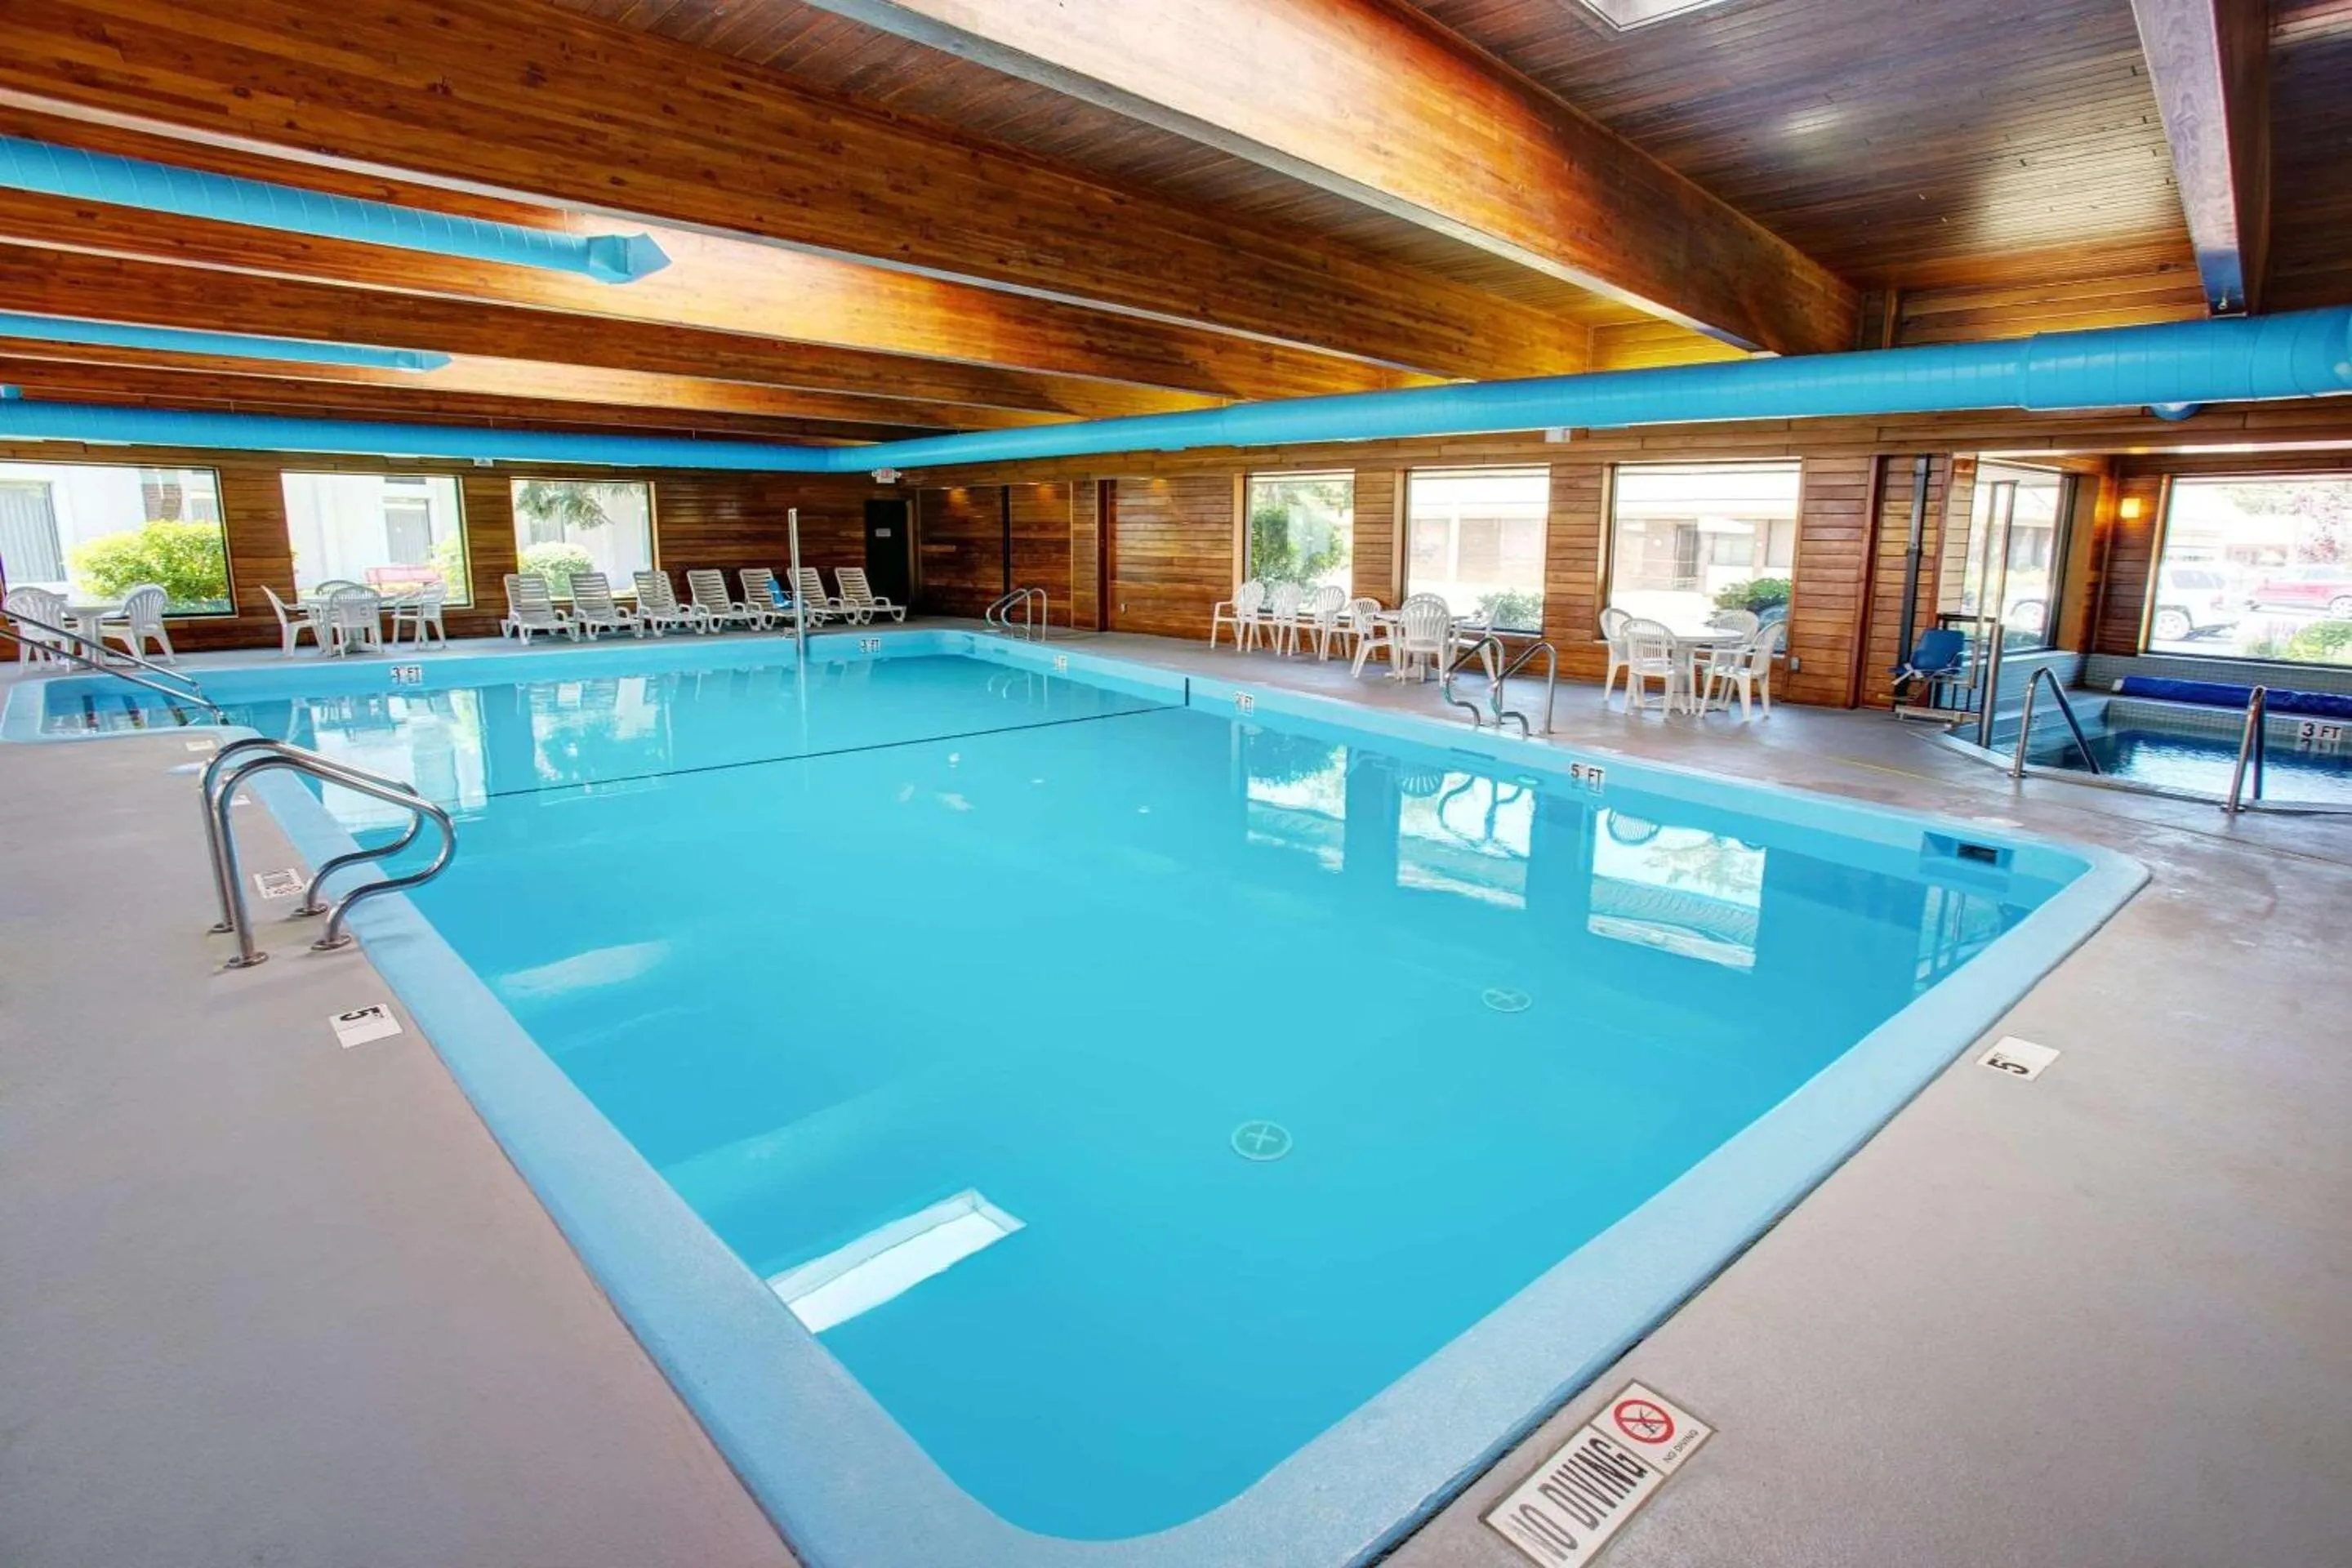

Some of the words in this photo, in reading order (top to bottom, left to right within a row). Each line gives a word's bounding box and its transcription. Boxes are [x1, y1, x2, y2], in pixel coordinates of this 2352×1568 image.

[2302, 722, 2315, 736] 3
[2321, 725, 2341, 739] FT
[1570, 763, 1580, 778] 5
[1588, 768, 1605, 786] FT
[339, 1006, 381, 1021] 5
[1987, 1058, 2029, 1075] 5
[1662, 1450, 1678, 1463] NO
[1673, 1429, 1699, 1452] DIVING
[1537, 1437, 1648, 1531] DIVING
[1508, 1503, 1579, 1566] NO
